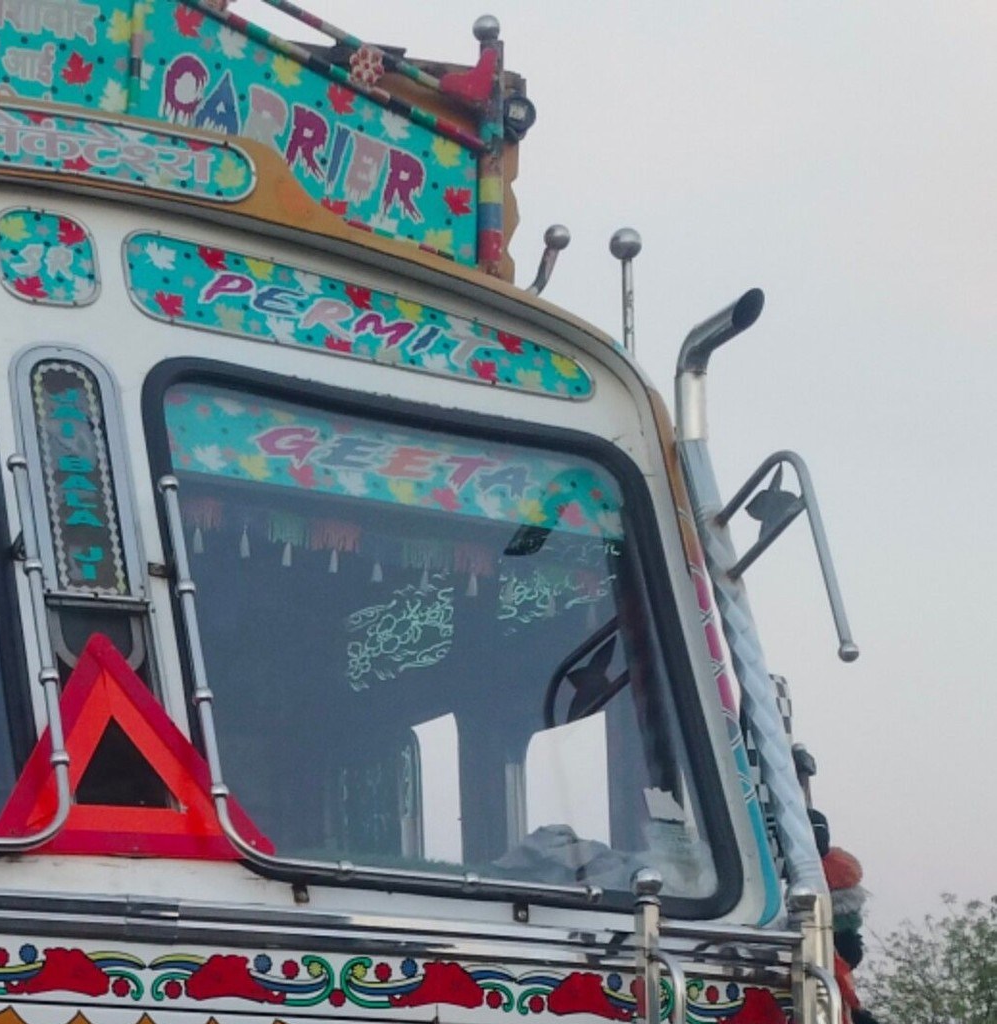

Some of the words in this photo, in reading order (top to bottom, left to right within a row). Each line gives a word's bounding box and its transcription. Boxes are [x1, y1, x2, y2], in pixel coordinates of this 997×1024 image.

[160, 52, 427, 224] CARRIER
[202, 270, 505, 369] PERMIT
[254, 424, 539, 499] GEETA
